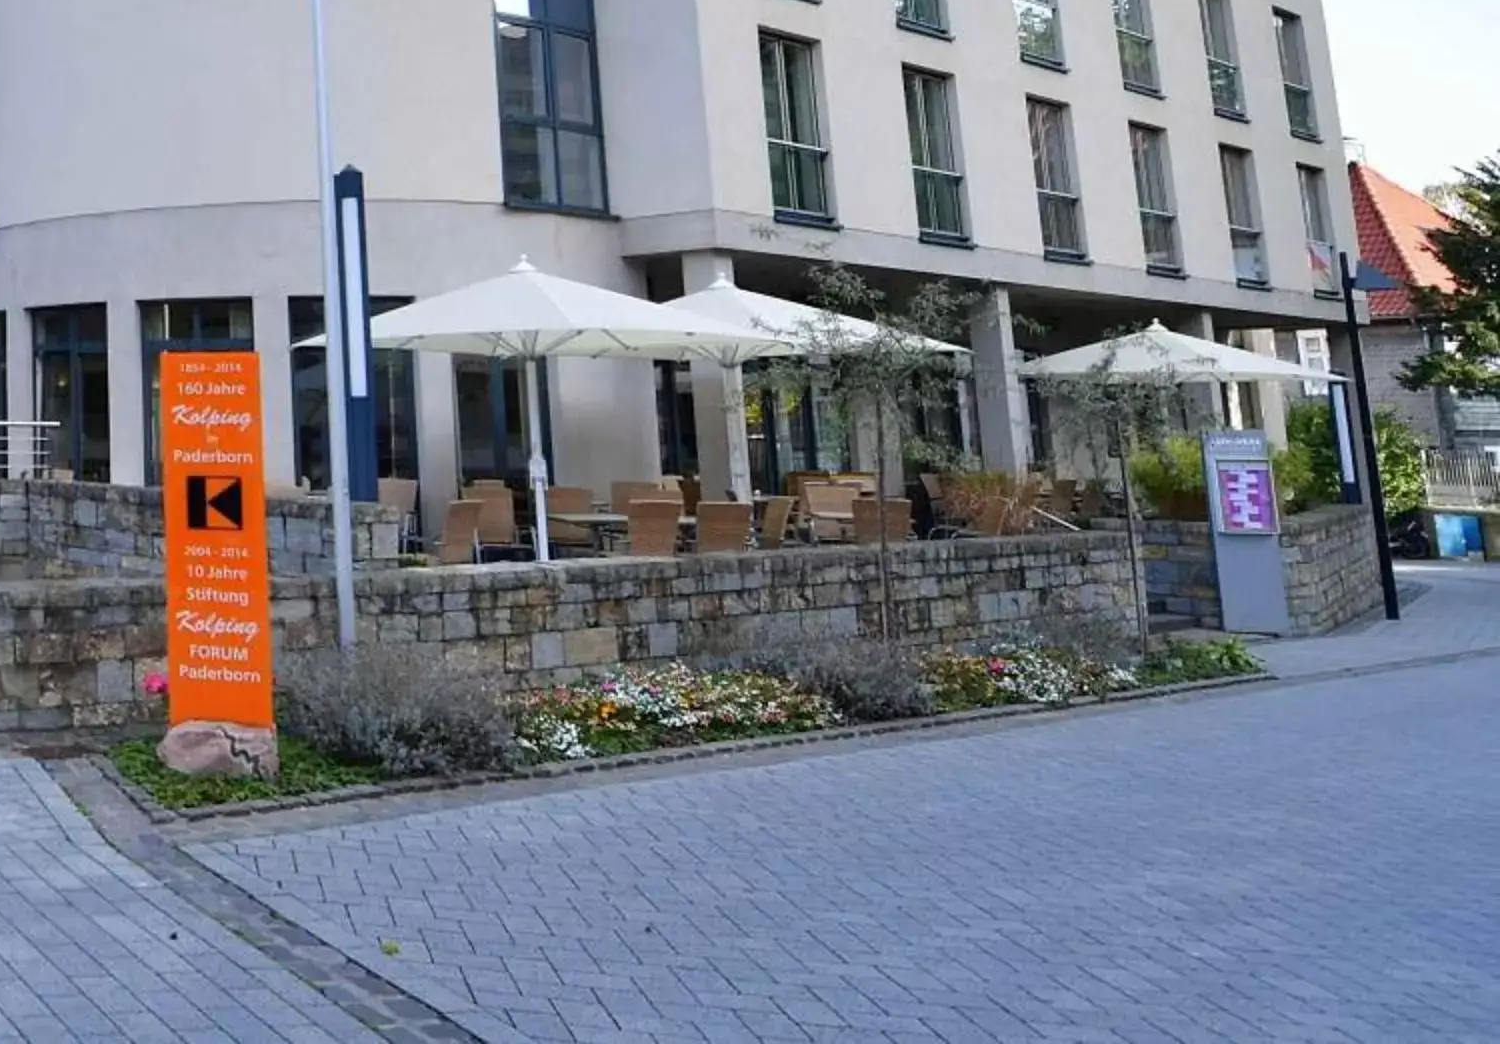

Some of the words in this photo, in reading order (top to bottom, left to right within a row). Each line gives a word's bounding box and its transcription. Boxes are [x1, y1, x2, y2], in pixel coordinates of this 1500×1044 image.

[214, 363, 243, 373] 2014
[177, 381, 203, 395] 160
[206, 381, 246, 395] Jahre
[171, 403, 253, 432] Kolping
[173, 448, 253, 465] Paderborn
[220, 547, 248, 559] 2014
[188, 564, 204, 578] 10
[207, 565, 248, 581] Jahre
[186, 586, 249, 608] Stiftung
[175, 609, 259, 644] Kolping
[189, 644, 249, 661] FORUM
[179, 664, 261, 684] Paderborn
